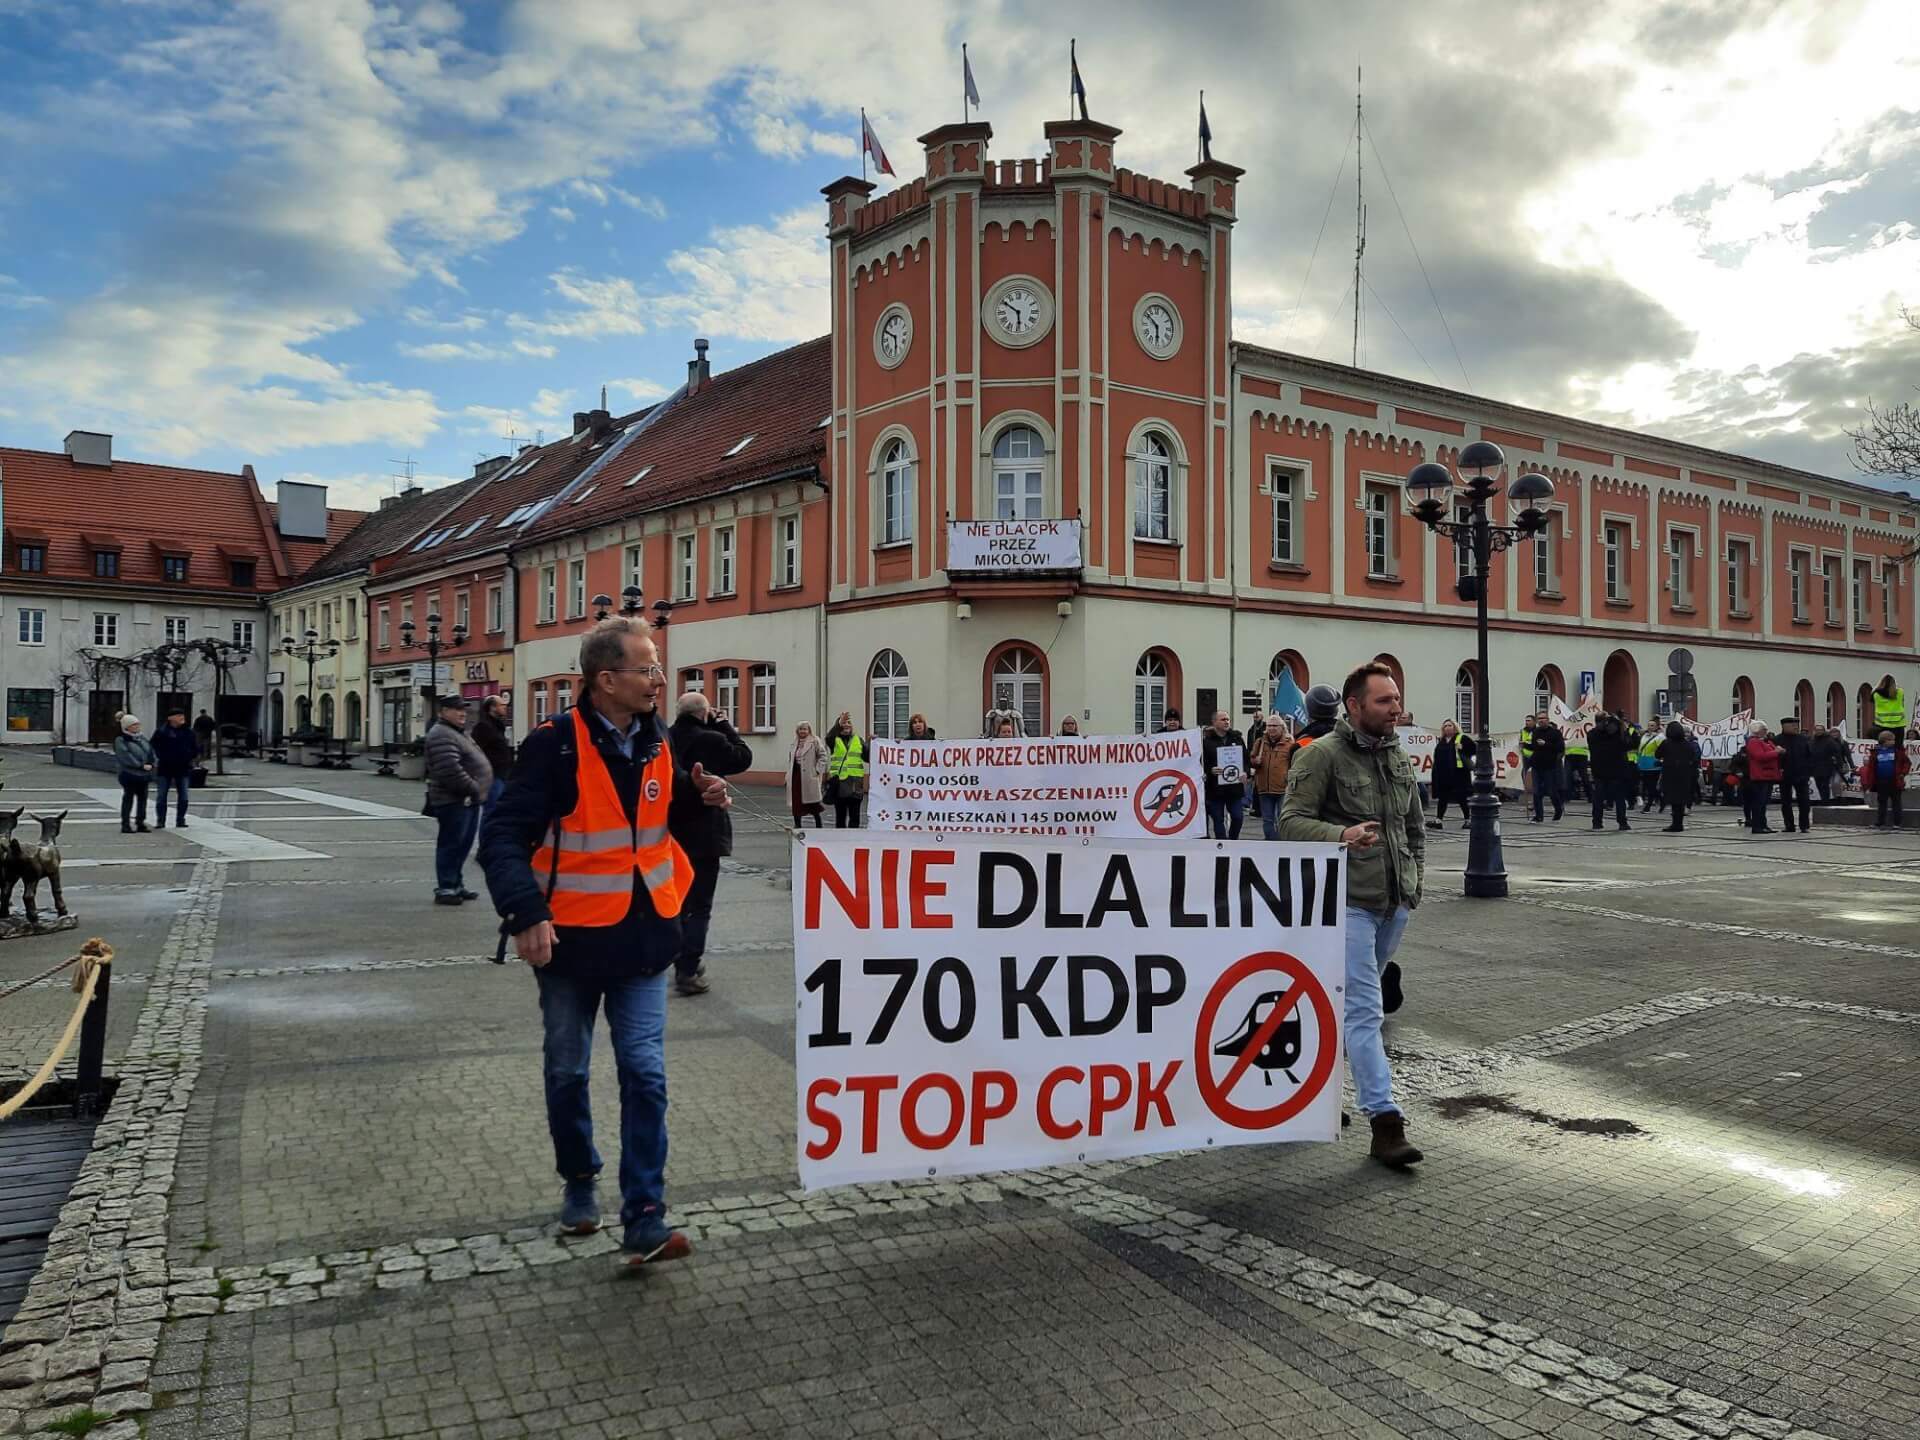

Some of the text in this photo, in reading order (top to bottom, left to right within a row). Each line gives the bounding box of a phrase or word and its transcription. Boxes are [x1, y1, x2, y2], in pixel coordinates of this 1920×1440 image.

[967, 523, 1059, 536] NIE DLA CPK
[989, 539, 1036, 551] PRZEZ
[975, 551, 1050, 566] MIKOŁÓW!
[1408, 735, 1433, 745] STOP
[879, 739, 1191, 767] NIE DLA CPK PRZEZ CENTRUM MIKOŁOWA
[897, 774, 979, 786] 1500 OSÓB
[895, 787, 1128, 801] DO WYWŁASZCZENIA!!!
[895, 809, 1117, 823] 317 MIESZKAŃ I 145 DOMÓW
[804, 847, 1339, 930] NIE DLA LINII
[803, 954, 1187, 1049] 170 KDP
[804, 1060, 1184, 1161] STOP CPK
